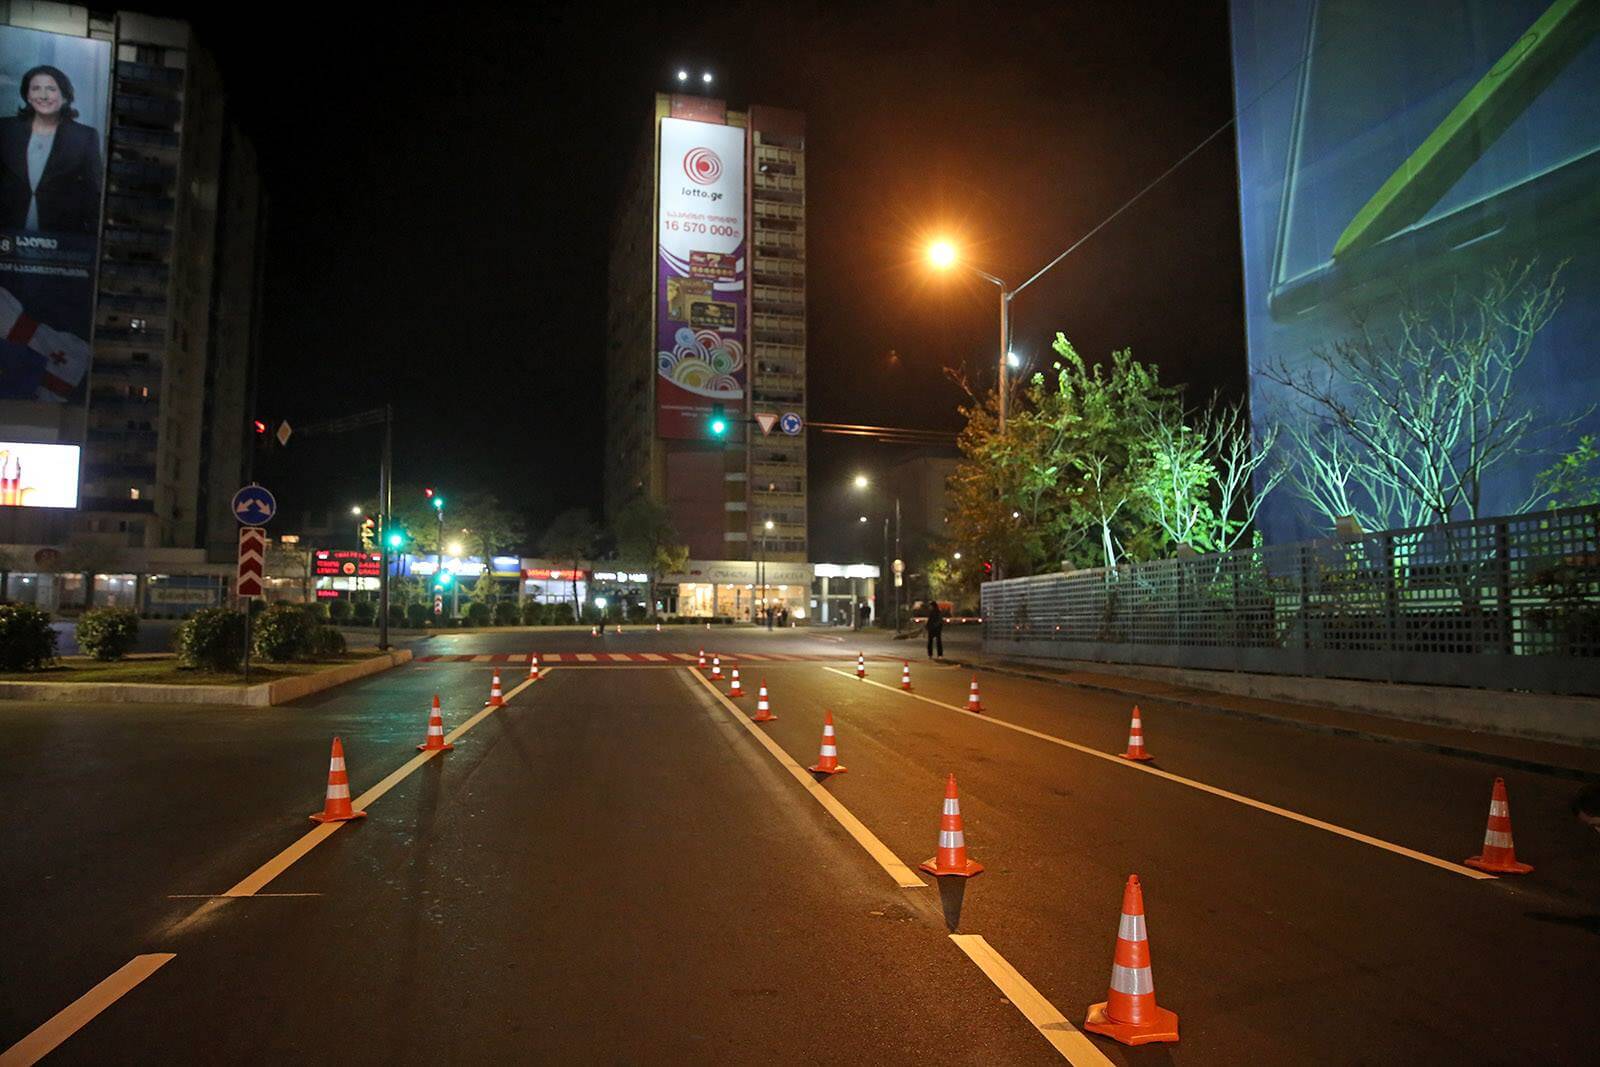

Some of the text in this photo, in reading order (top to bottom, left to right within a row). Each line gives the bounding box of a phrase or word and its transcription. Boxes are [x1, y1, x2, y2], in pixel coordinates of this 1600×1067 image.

[681, 187, 723, 201] lotto.ge
[664, 220, 679, 230] 16
[683, 222, 706, 233] 570
